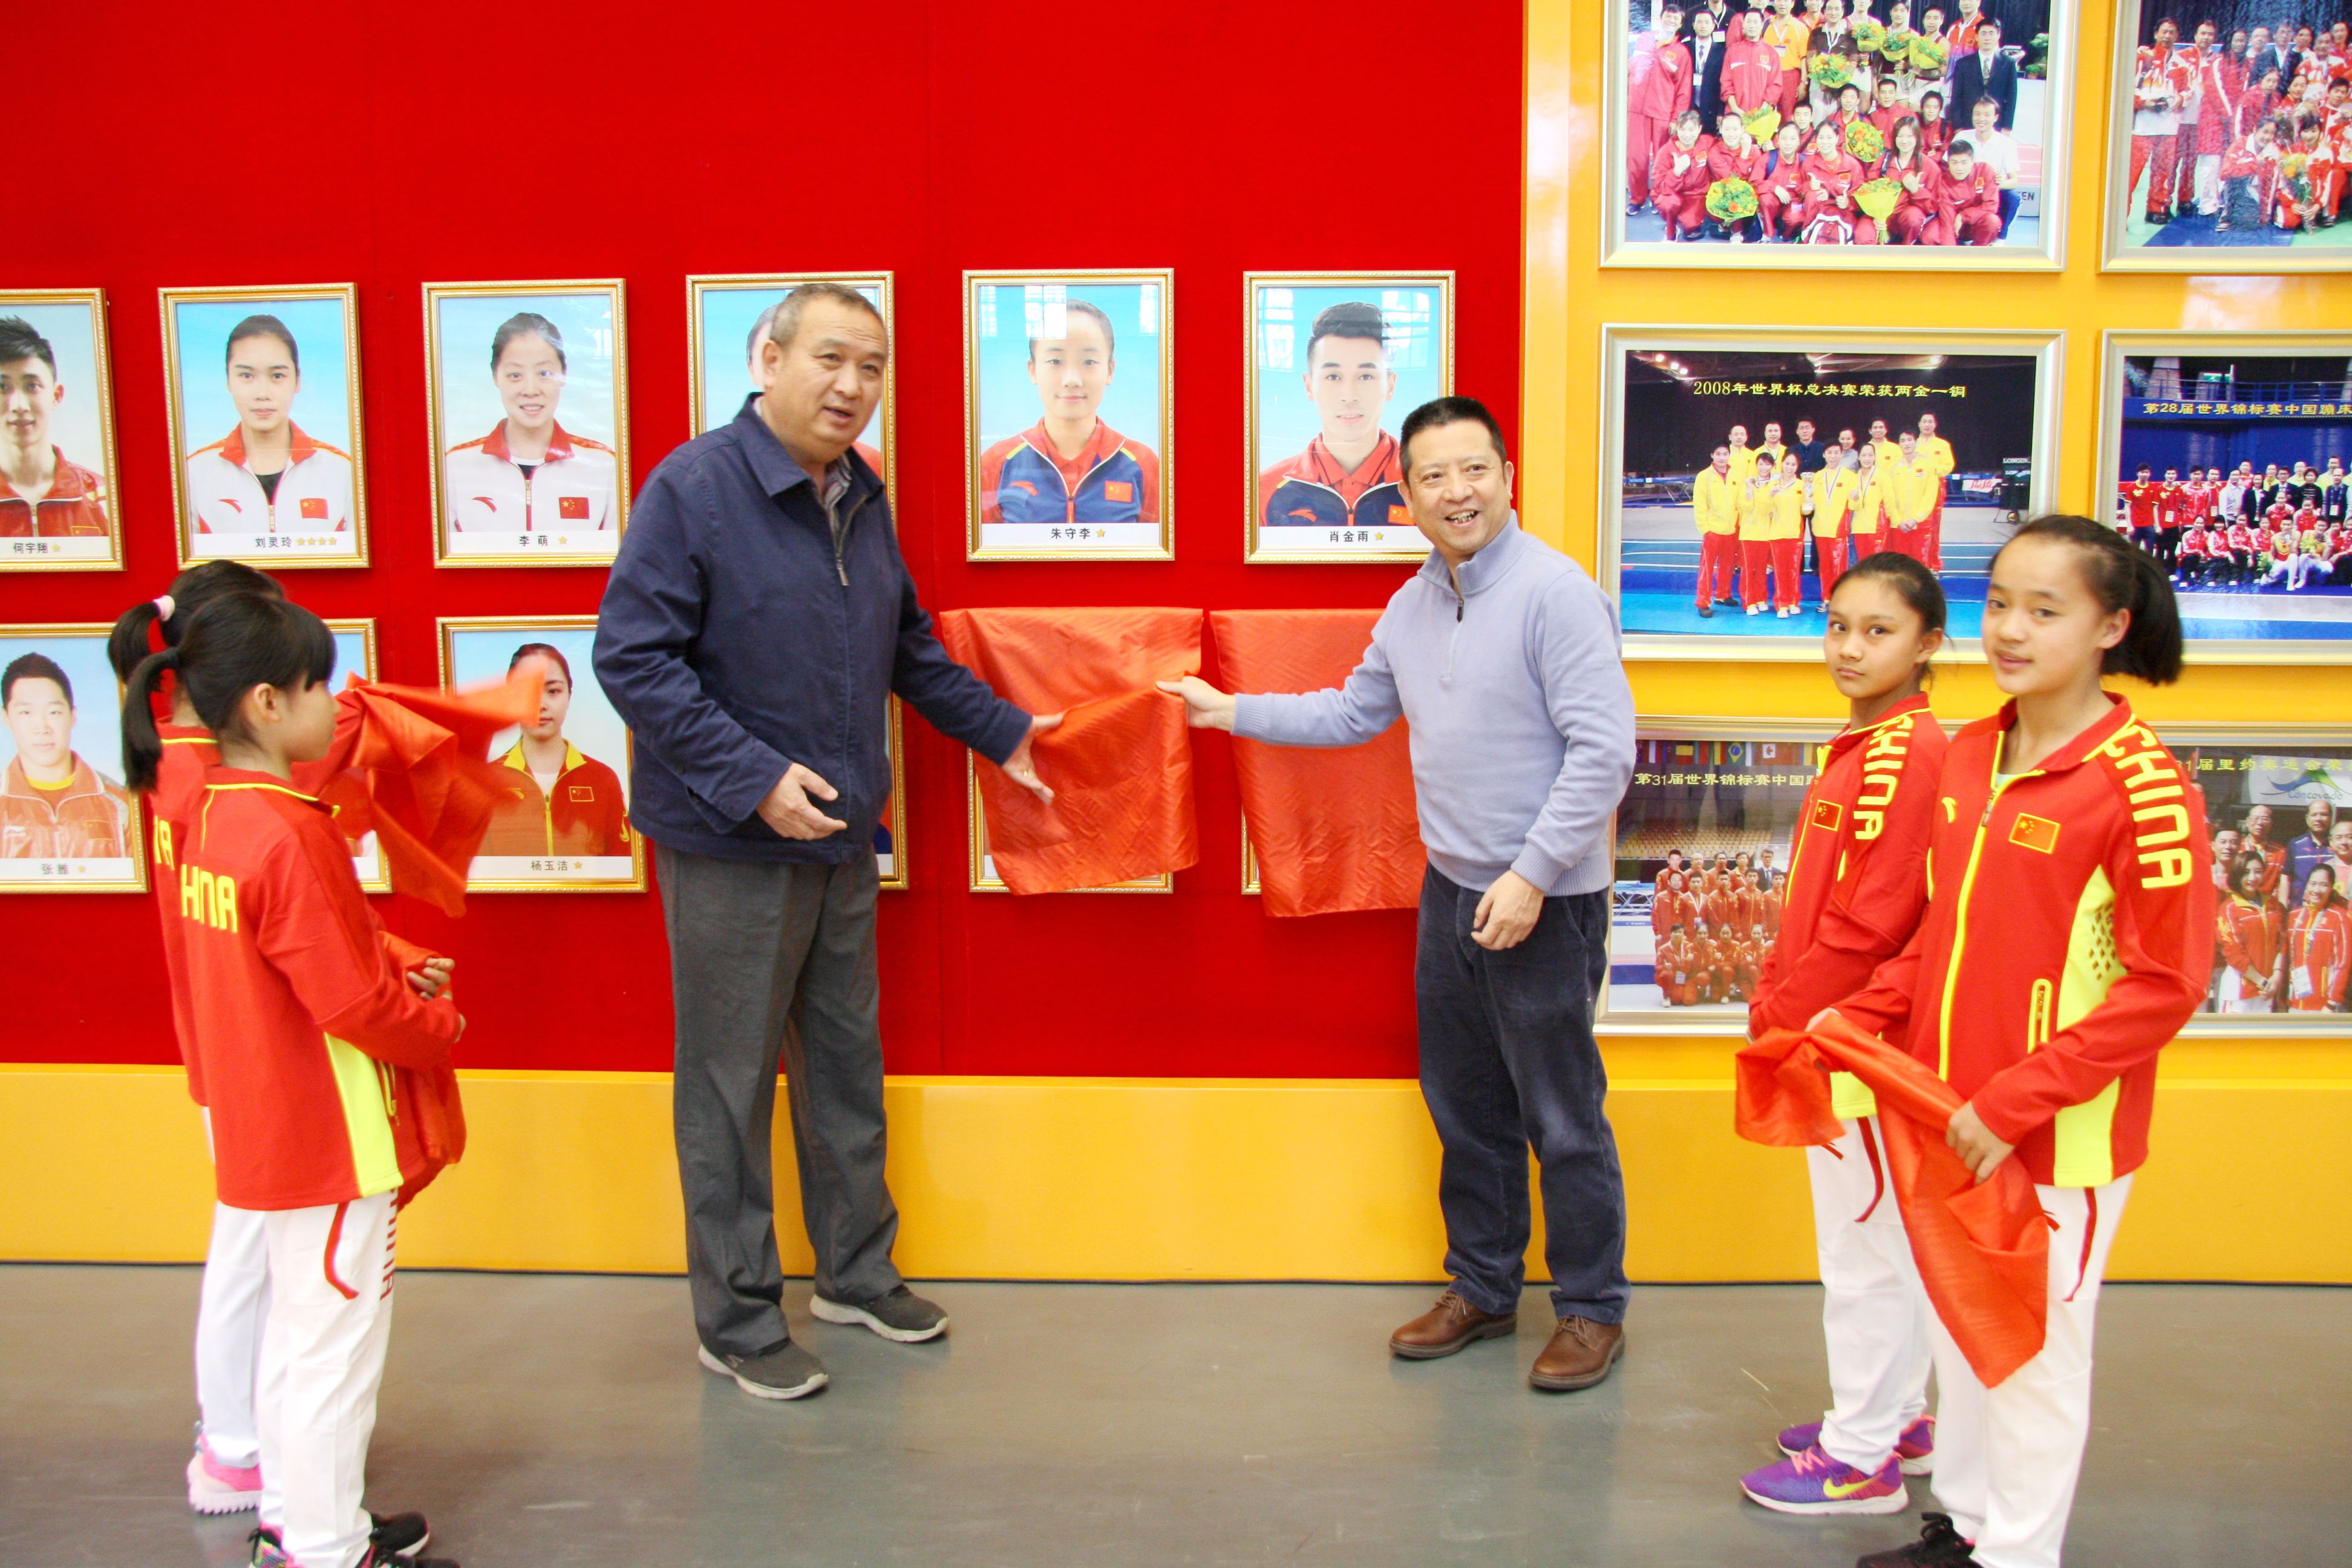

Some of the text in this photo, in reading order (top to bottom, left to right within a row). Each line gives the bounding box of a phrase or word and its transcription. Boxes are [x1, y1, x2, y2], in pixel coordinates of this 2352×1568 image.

[1693, 381, 1966, 397] 2008年世界杯总决赛荣获两金一铜
[1051, 528, 1091, 540] 朱守李
[1330, 531, 1368, 543] 肖金雨
[255, 536, 292, 548] 刘灵玲
[519, 535, 548, 546] 李萌
[13, 542, 48, 554] 何宇翔
[2102, 724, 2193, 889] CHINA
[531, 860, 569, 871] 杨玉洁
